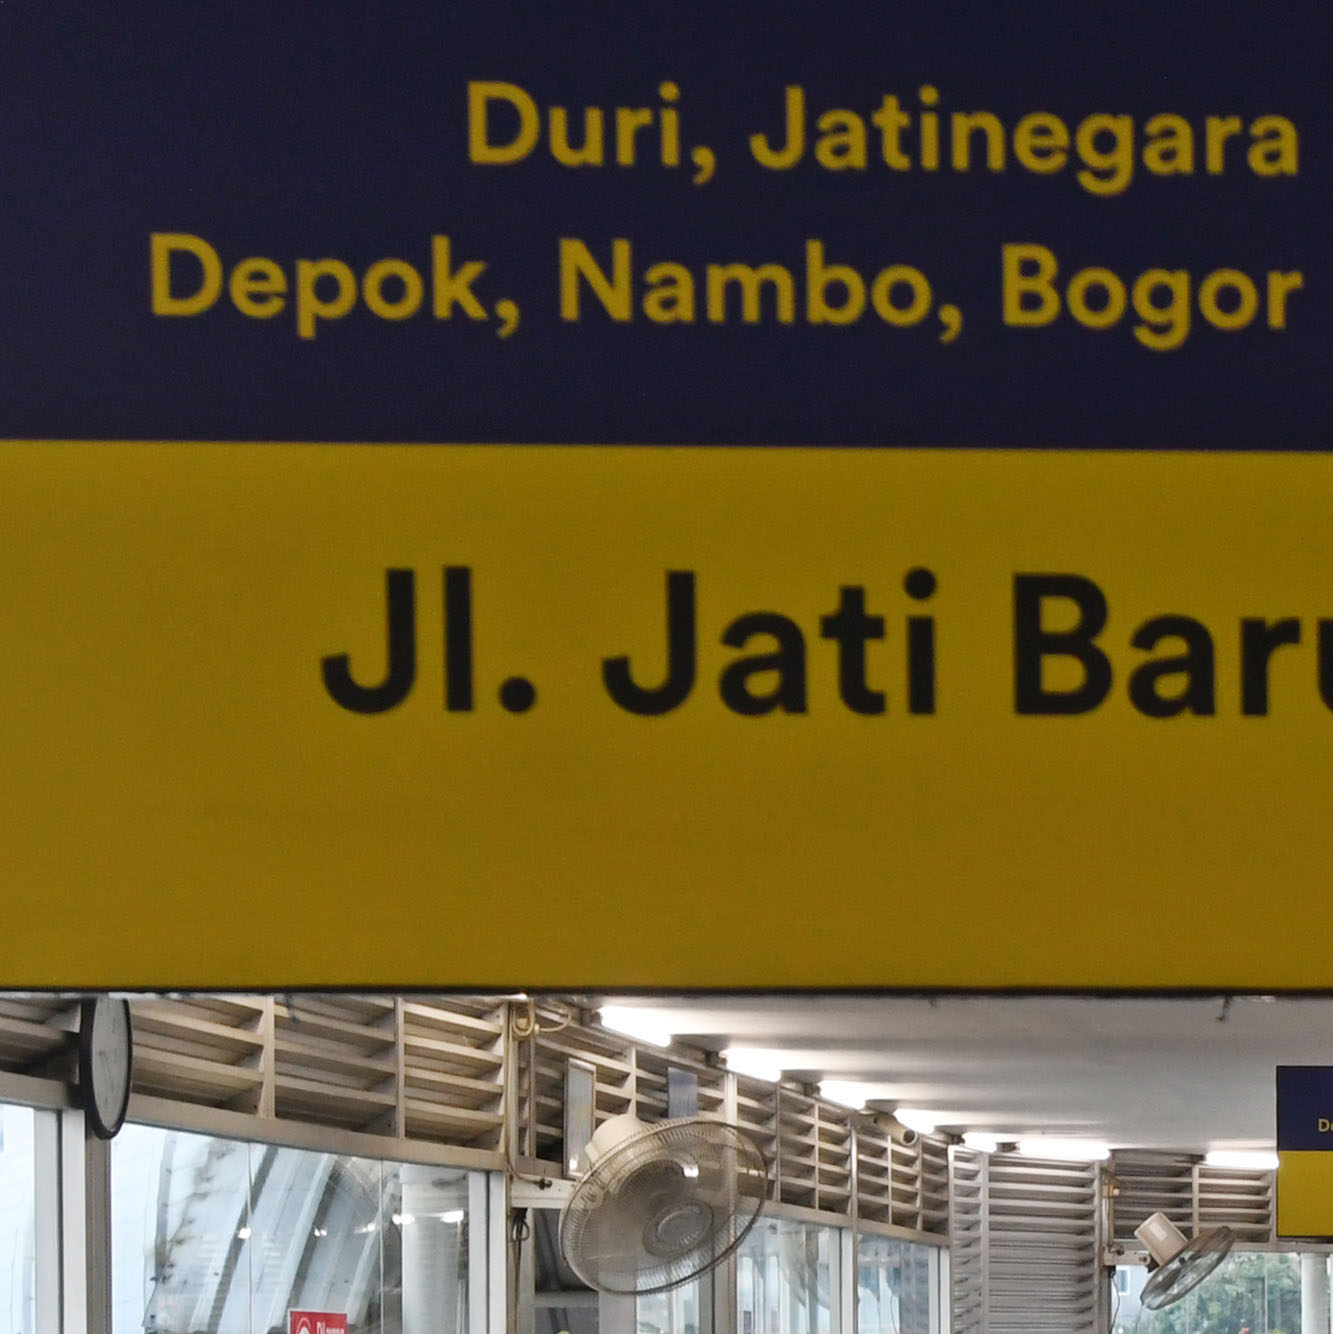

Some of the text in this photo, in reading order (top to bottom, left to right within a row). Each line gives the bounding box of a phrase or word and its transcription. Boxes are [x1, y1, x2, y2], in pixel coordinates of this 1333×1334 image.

[467, 80, 1300, 196] Duri, Jatinegara
[150, 232, 1304, 352] Depok, Nambo, Bogor
[320, 564, 538, 716] Jl.
[601, 565, 938, 718] Jati
